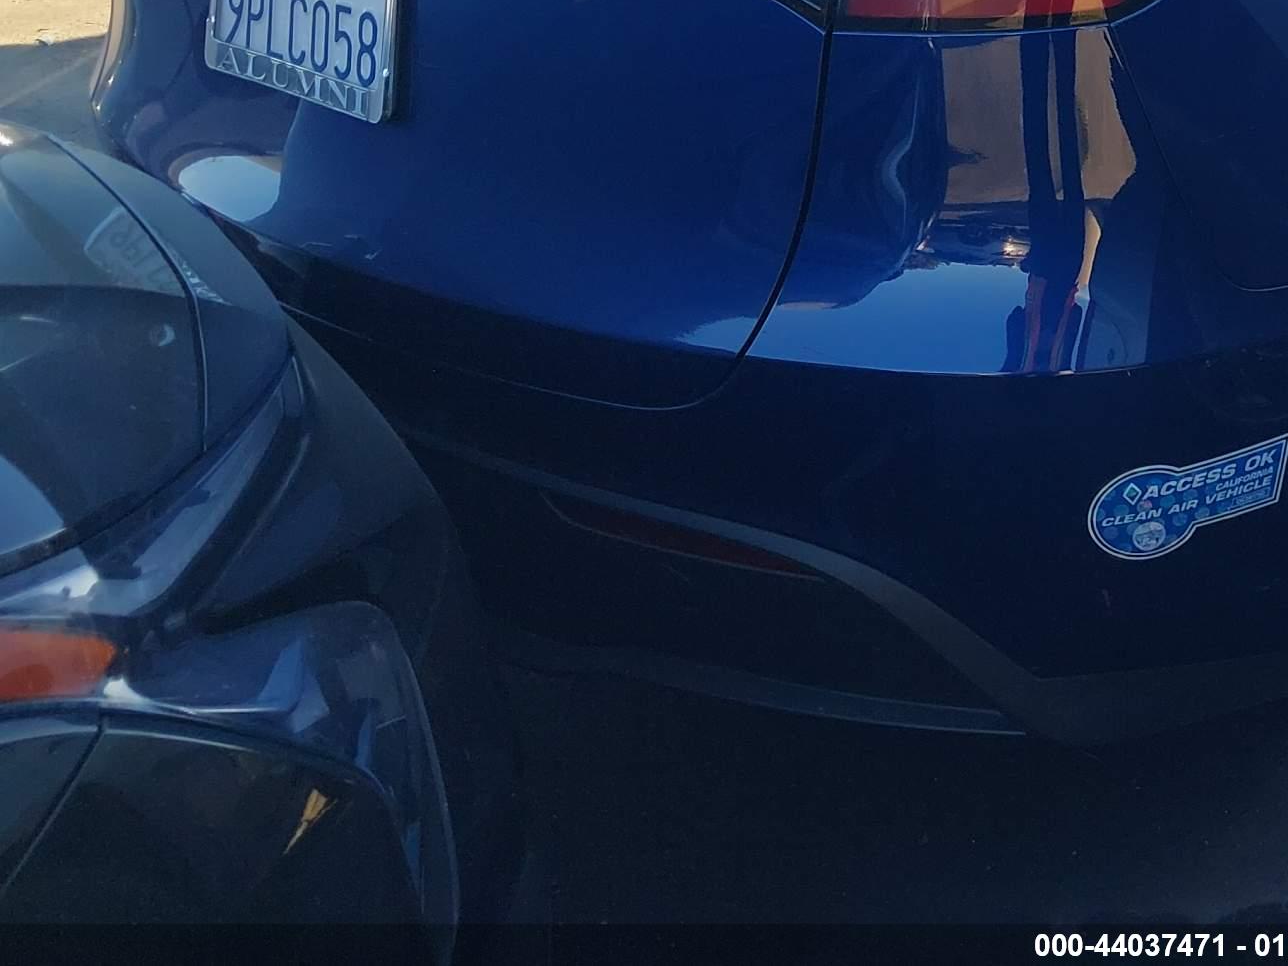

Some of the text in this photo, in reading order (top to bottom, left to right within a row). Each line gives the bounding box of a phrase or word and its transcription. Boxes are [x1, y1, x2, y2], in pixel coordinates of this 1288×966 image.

[217, 47, 370, 117] ALUMNI
[1142, 463, 1237, 500] ACCESS
[1244, 449, 1277, 472] OK
[1215, 466, 1274, 492] CALIFORNIA
[1101, 508, 1162, 528] CLEAN
[1168, 499, 1199, 515] AIR
[1206, 476, 1273, 505] VEHICLE
